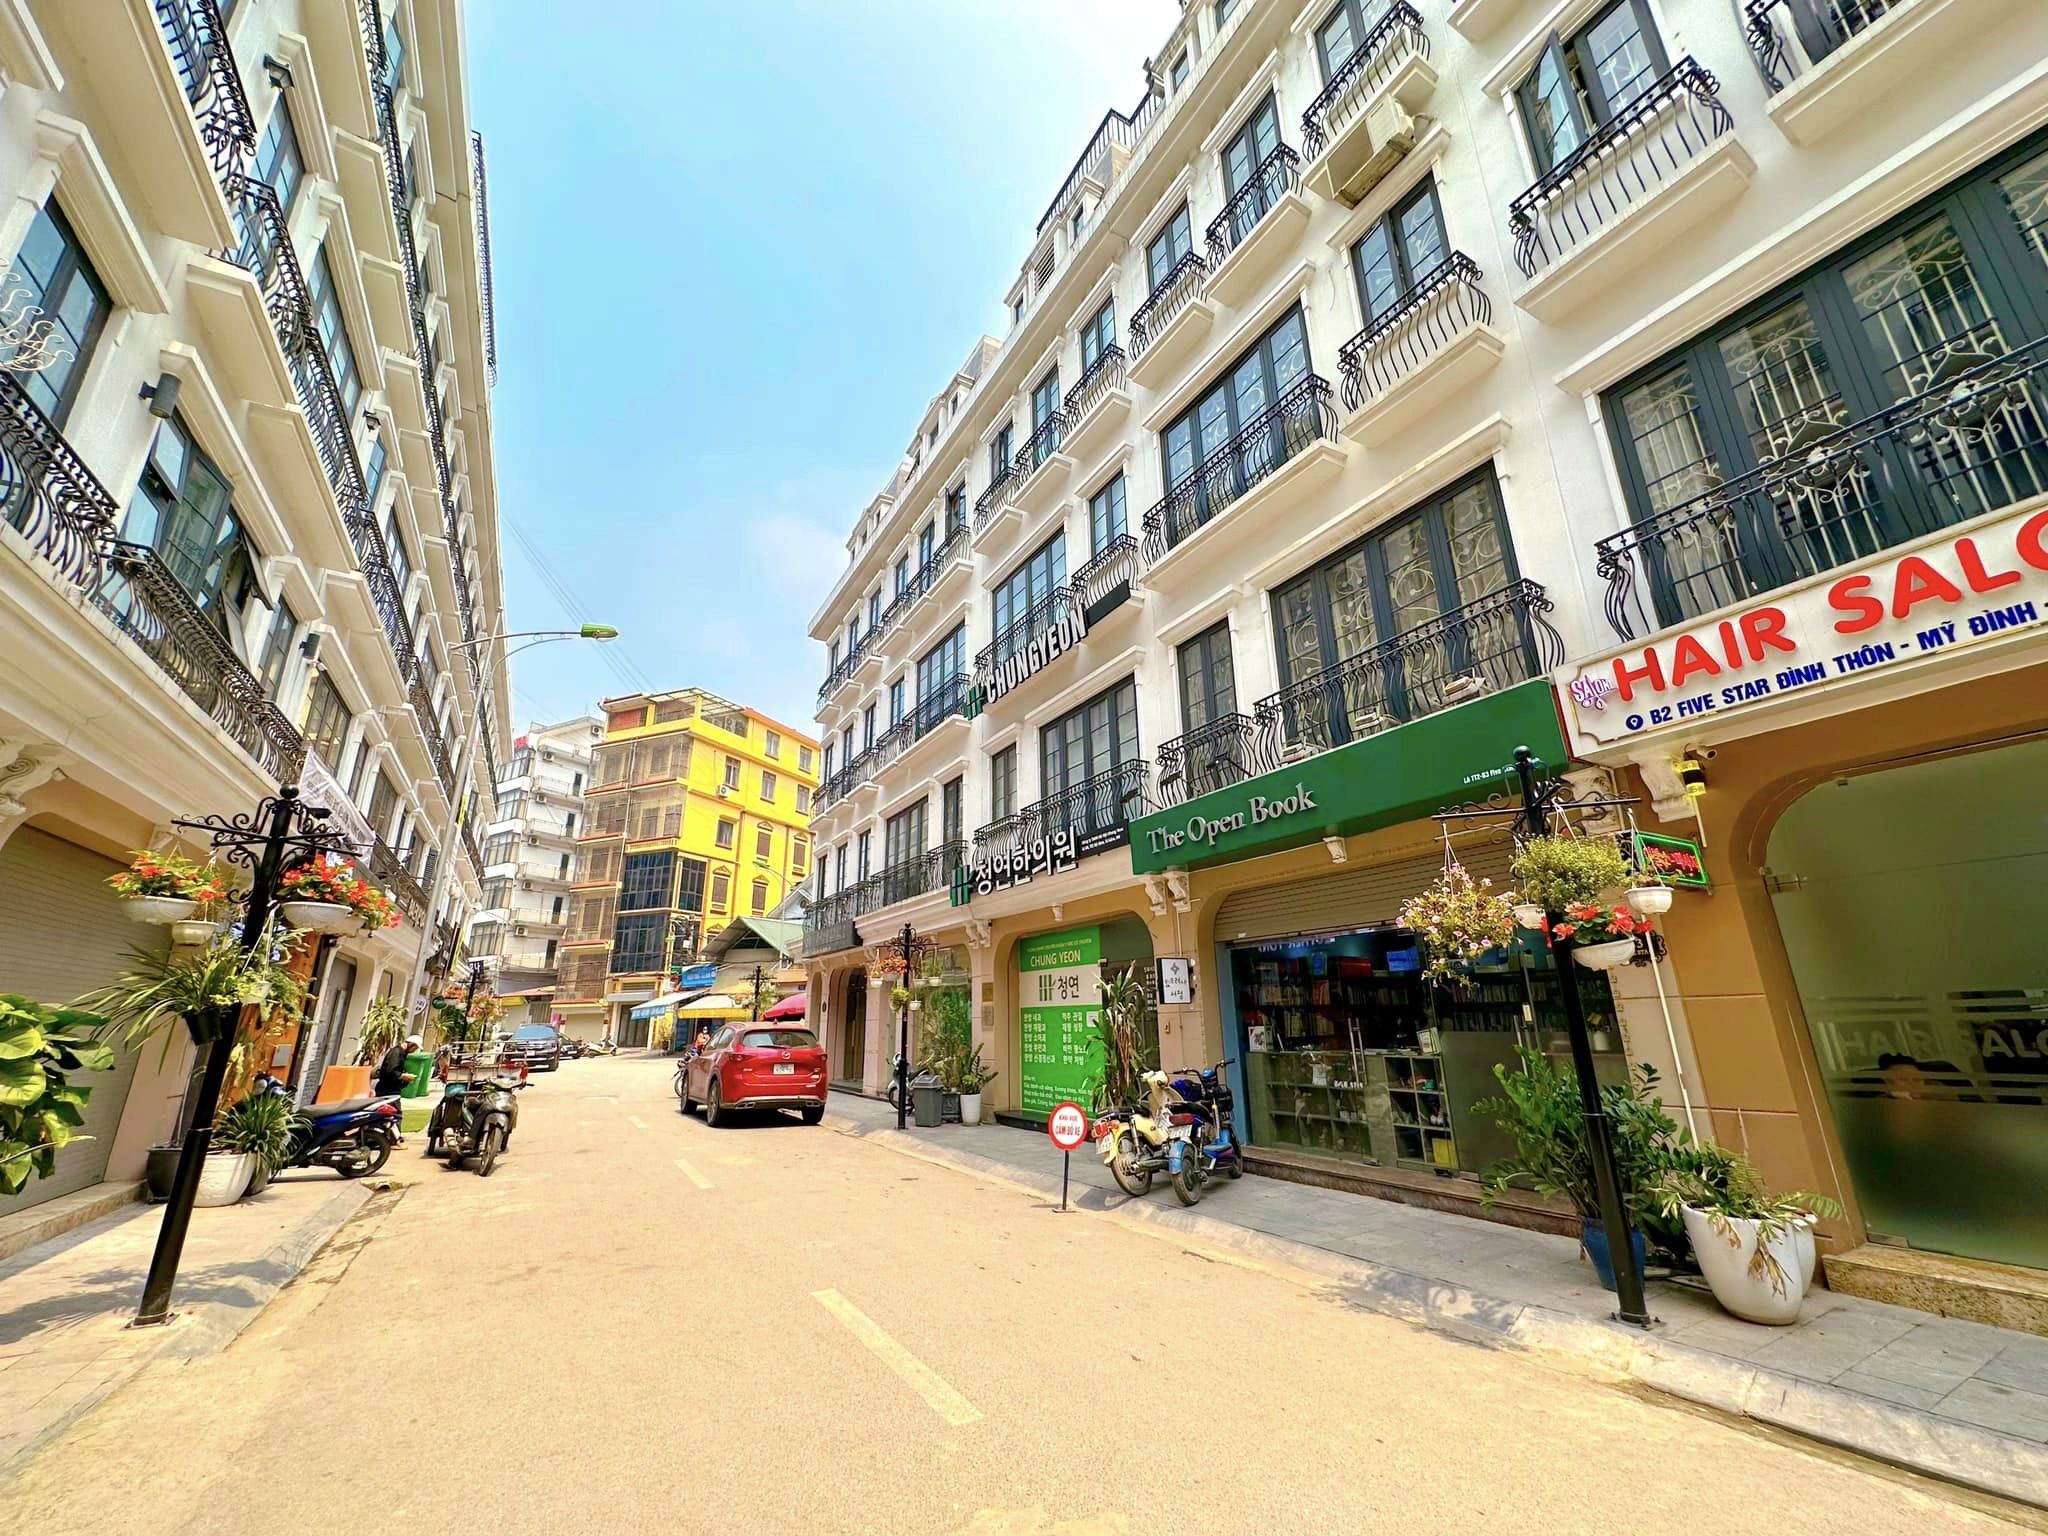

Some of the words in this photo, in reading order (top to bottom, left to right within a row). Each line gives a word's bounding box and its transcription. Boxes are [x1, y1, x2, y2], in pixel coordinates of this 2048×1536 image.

[985, 604, 1089, 704] CHUNGYEON
[1612, 607, 1797, 702] HAIR
[1650, 705, 1673, 725] B2
[1677, 693, 1716, 718] FIVE
[1721, 678, 1771, 705] STAR
[1776, 662, 1827, 690] ĐÌNH
[1832, 642, 1896, 673] THÔN
[1916, 621, 1956, 651] MỸ
[1968, 601, 2038, 637] ĐÌNH
[1146, 825, 1185, 854] The
[1187, 810, 1247, 847] Open
[1248, 782, 1319, 825] Book
[975, 826, 1078, 896] 청연한의원
[1030, 952, 1057, 967] CHUNG
[1058, 949, 1081, 963] YEON
[1057, 974, 1079, 1000] 청연
